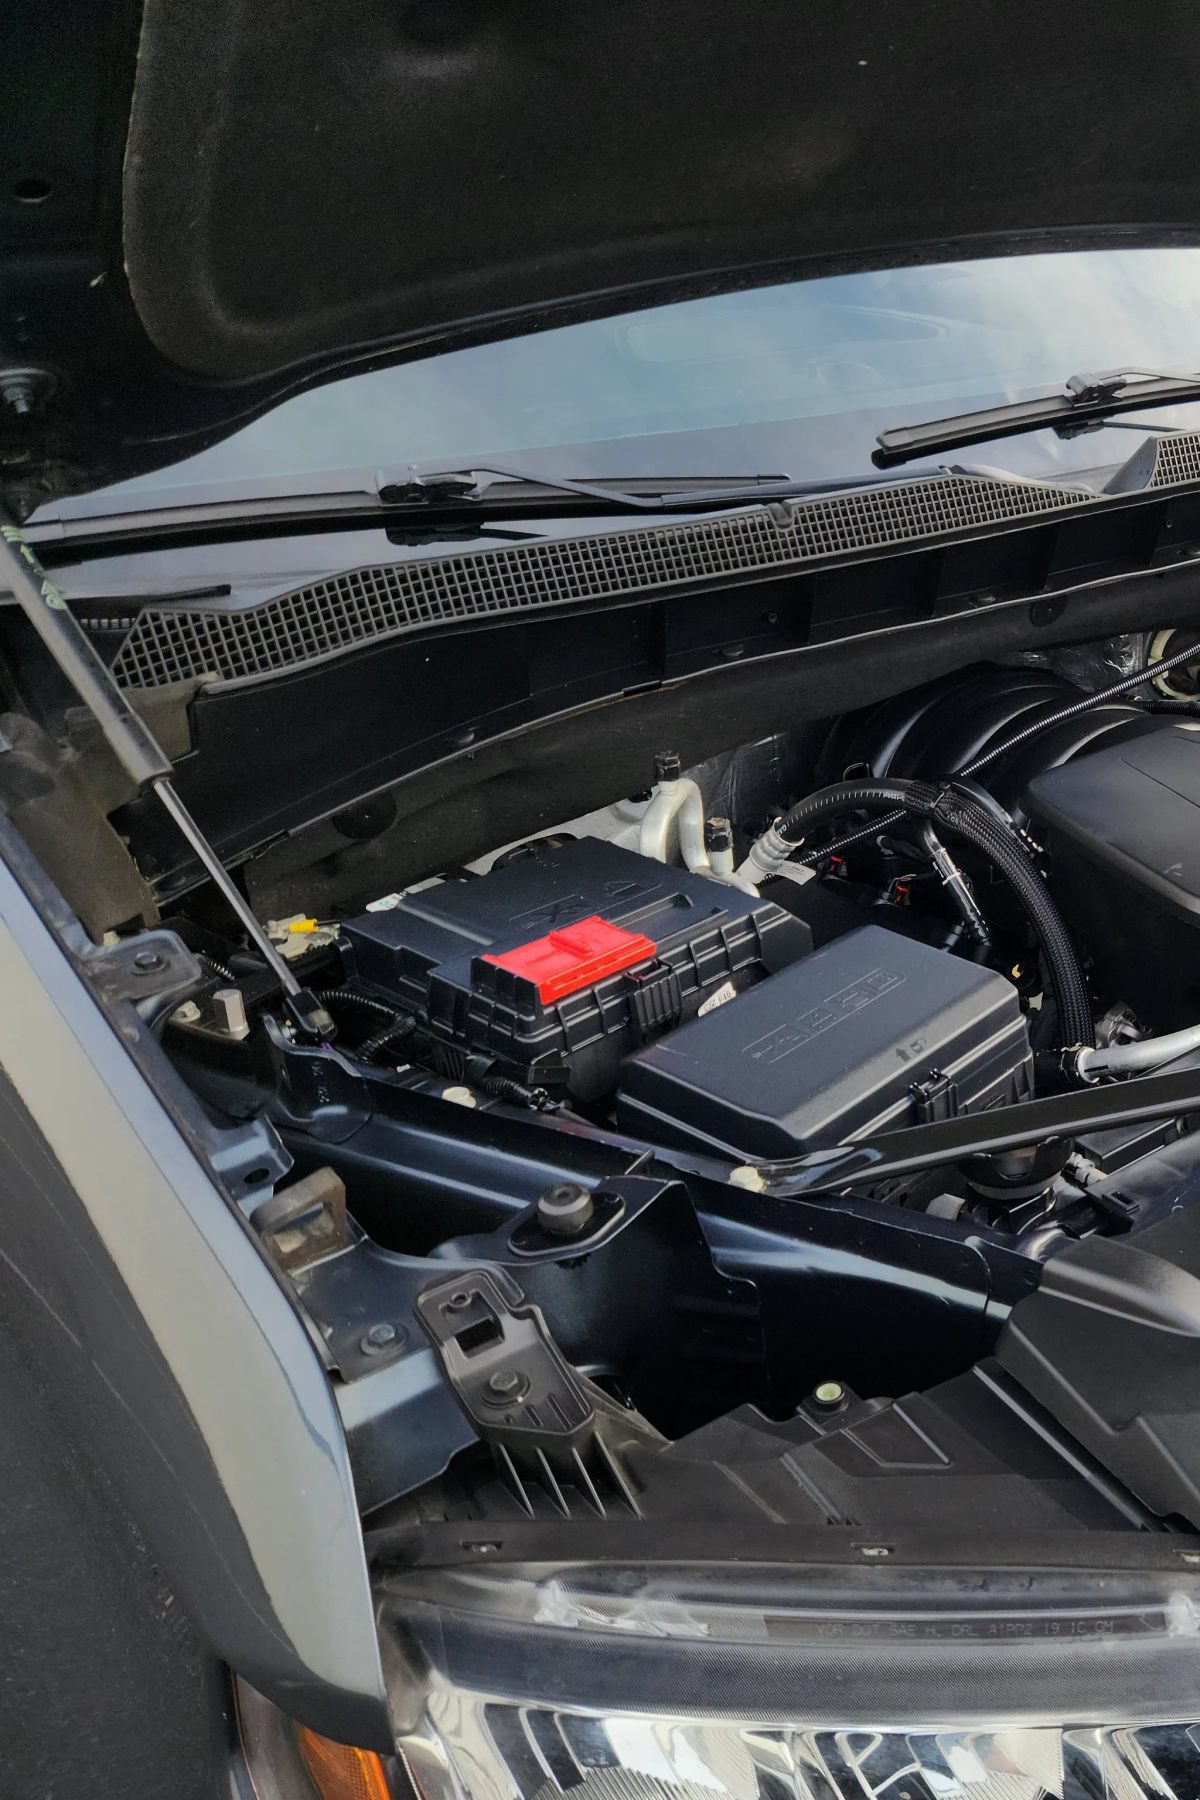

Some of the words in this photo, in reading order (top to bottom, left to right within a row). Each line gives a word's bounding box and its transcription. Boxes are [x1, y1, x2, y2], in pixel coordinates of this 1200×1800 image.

[888, 1624, 917, 1637] SAE
[951, 1624, 979, 1637] DRL
[1094, 1619, 1114, 1634] GM
